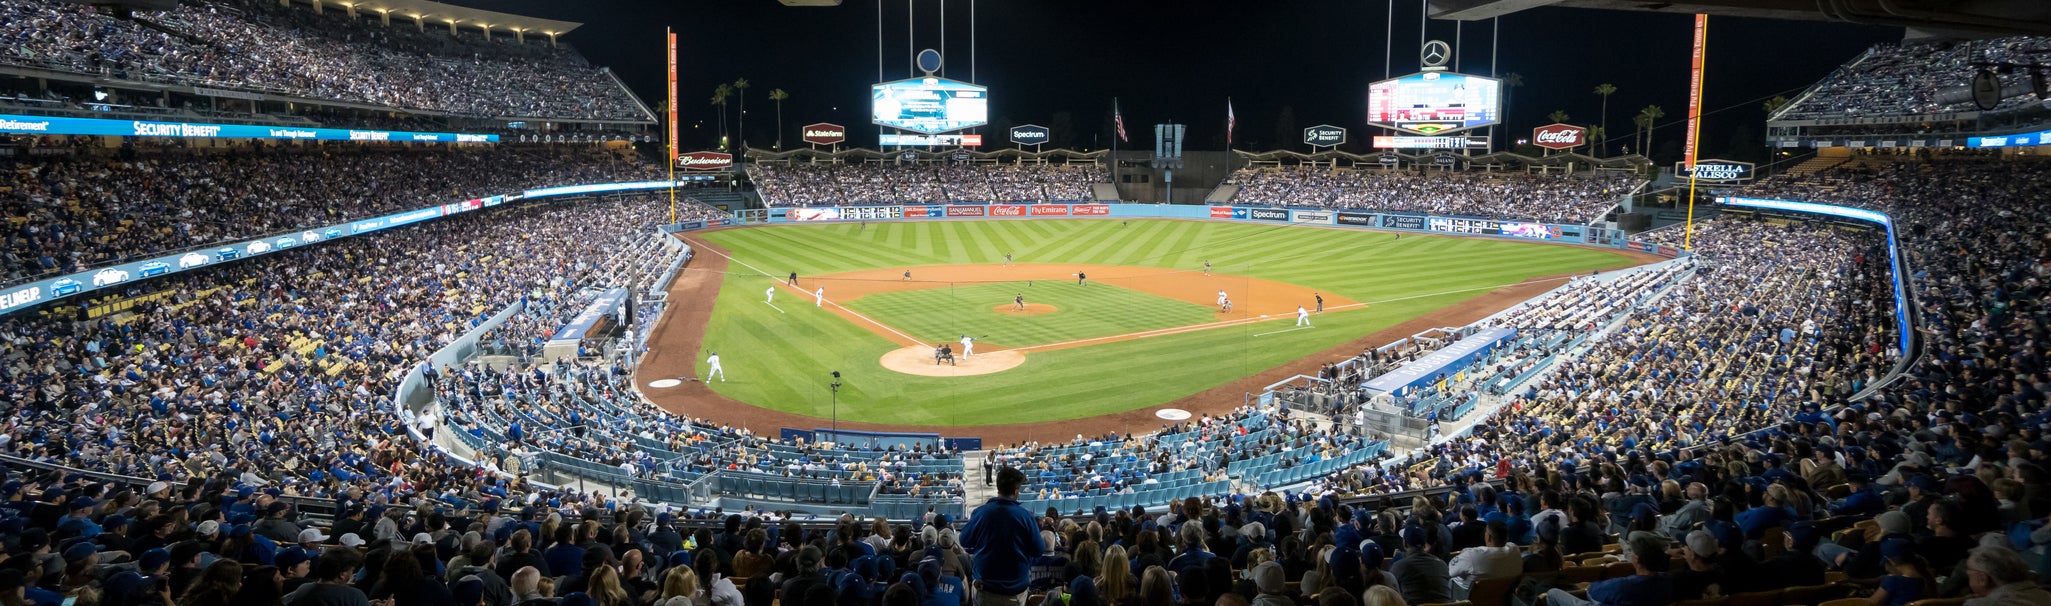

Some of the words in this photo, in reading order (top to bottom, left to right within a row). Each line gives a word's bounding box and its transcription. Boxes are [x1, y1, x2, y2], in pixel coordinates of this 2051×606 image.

[134, 121, 180, 135] SECURITY
[350, 130, 370, 140] SECURITY
[1014, 131, 1044, 139] Spectrum
[1537, 130, 1579, 143] Coca-Cola
[678, 156, 730, 165] Budweiser
[994, 207, 1020, 215] Coca-Cola
[1253, 210, 1285, 218] Spectrum
